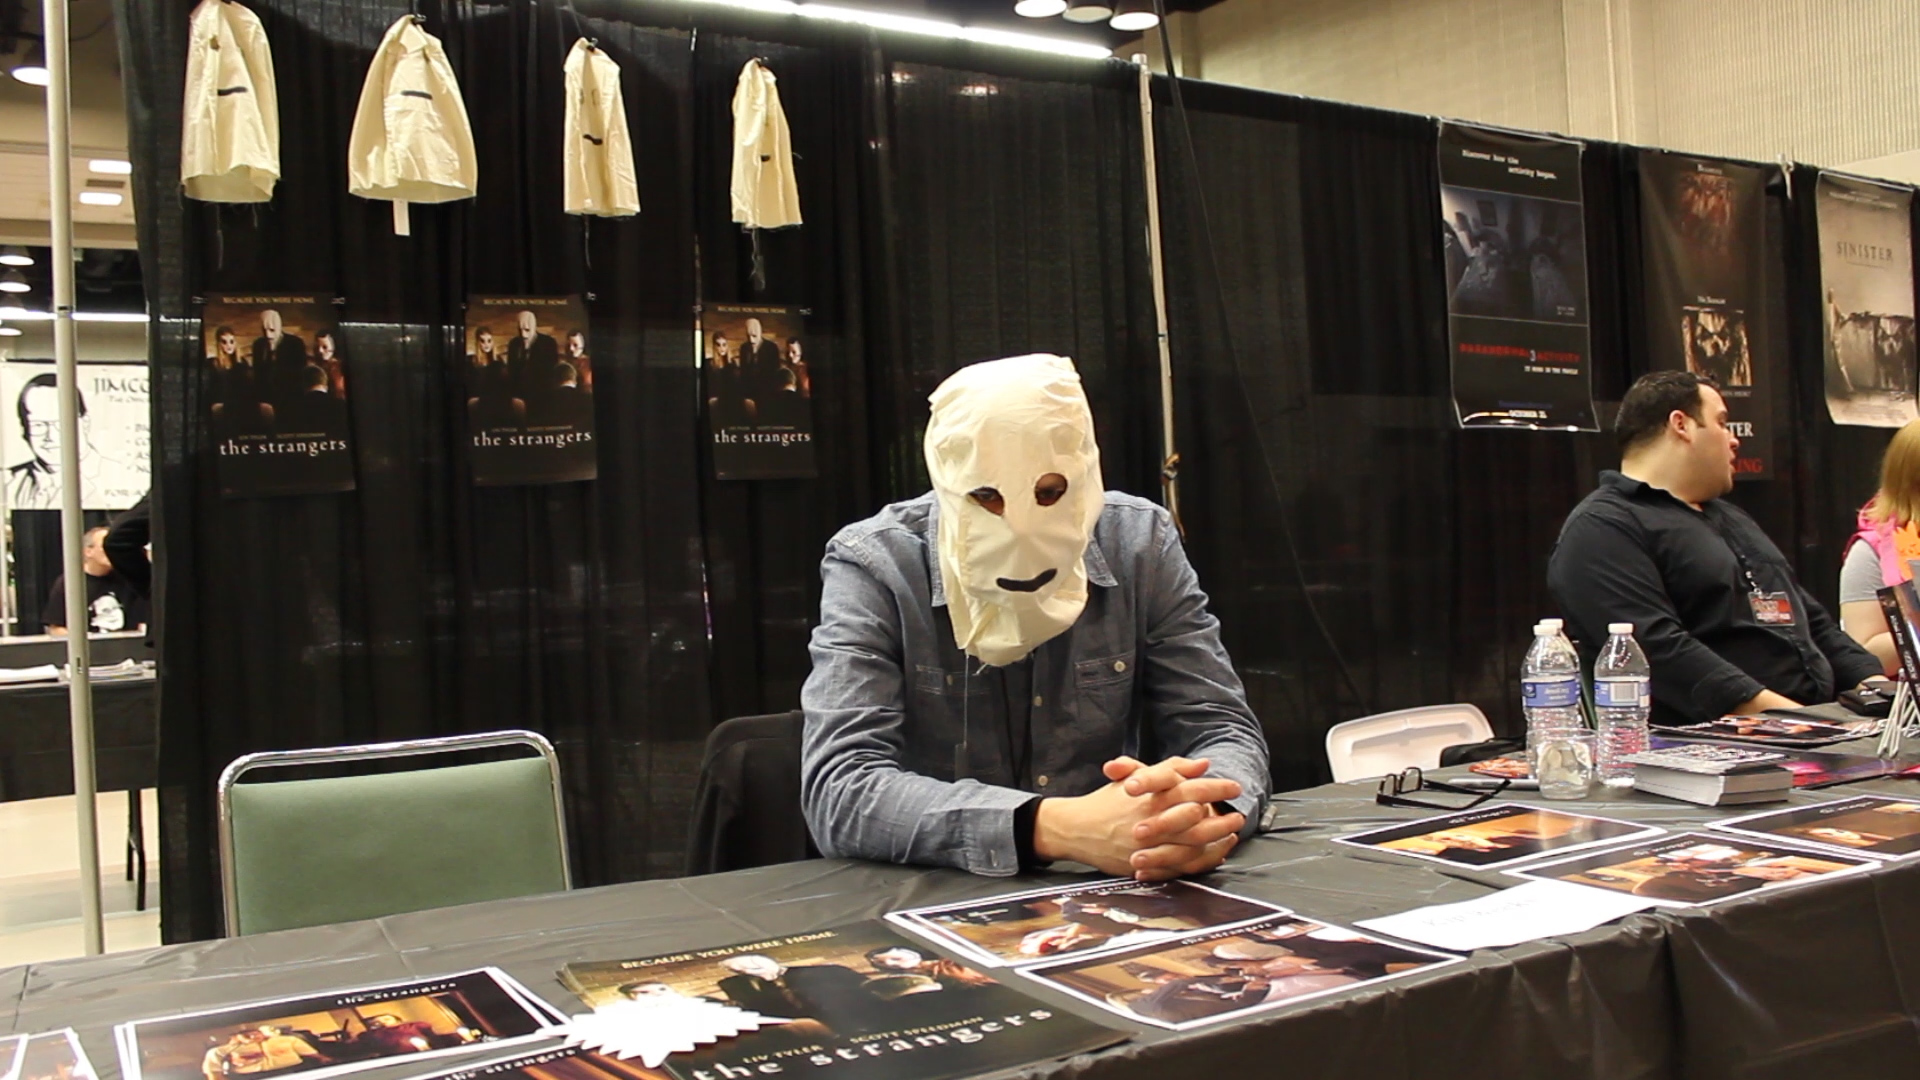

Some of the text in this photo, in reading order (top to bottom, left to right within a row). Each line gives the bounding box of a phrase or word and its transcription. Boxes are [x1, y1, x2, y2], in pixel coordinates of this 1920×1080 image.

[1836, 240, 1894, 262] SINISTER
[474, 431, 592, 448] the strangers
[714, 429, 811, 447] the strangers
[1726, 421, 1754, 437] TER
[220, 439, 347, 457] the strangers
[620, 952, 695, 970] BECAUSE
[697, 946, 735, 960] YOU
[737, 939, 784, 954] WERE
[850, 1015, 985, 1044] SCOTT SPEEDMAN
[692, 1008, 1053, 1080] the strangers
[742, 1044, 824, 1064] LIV TYLER
[485, 1049, 576, 1074] strangers
